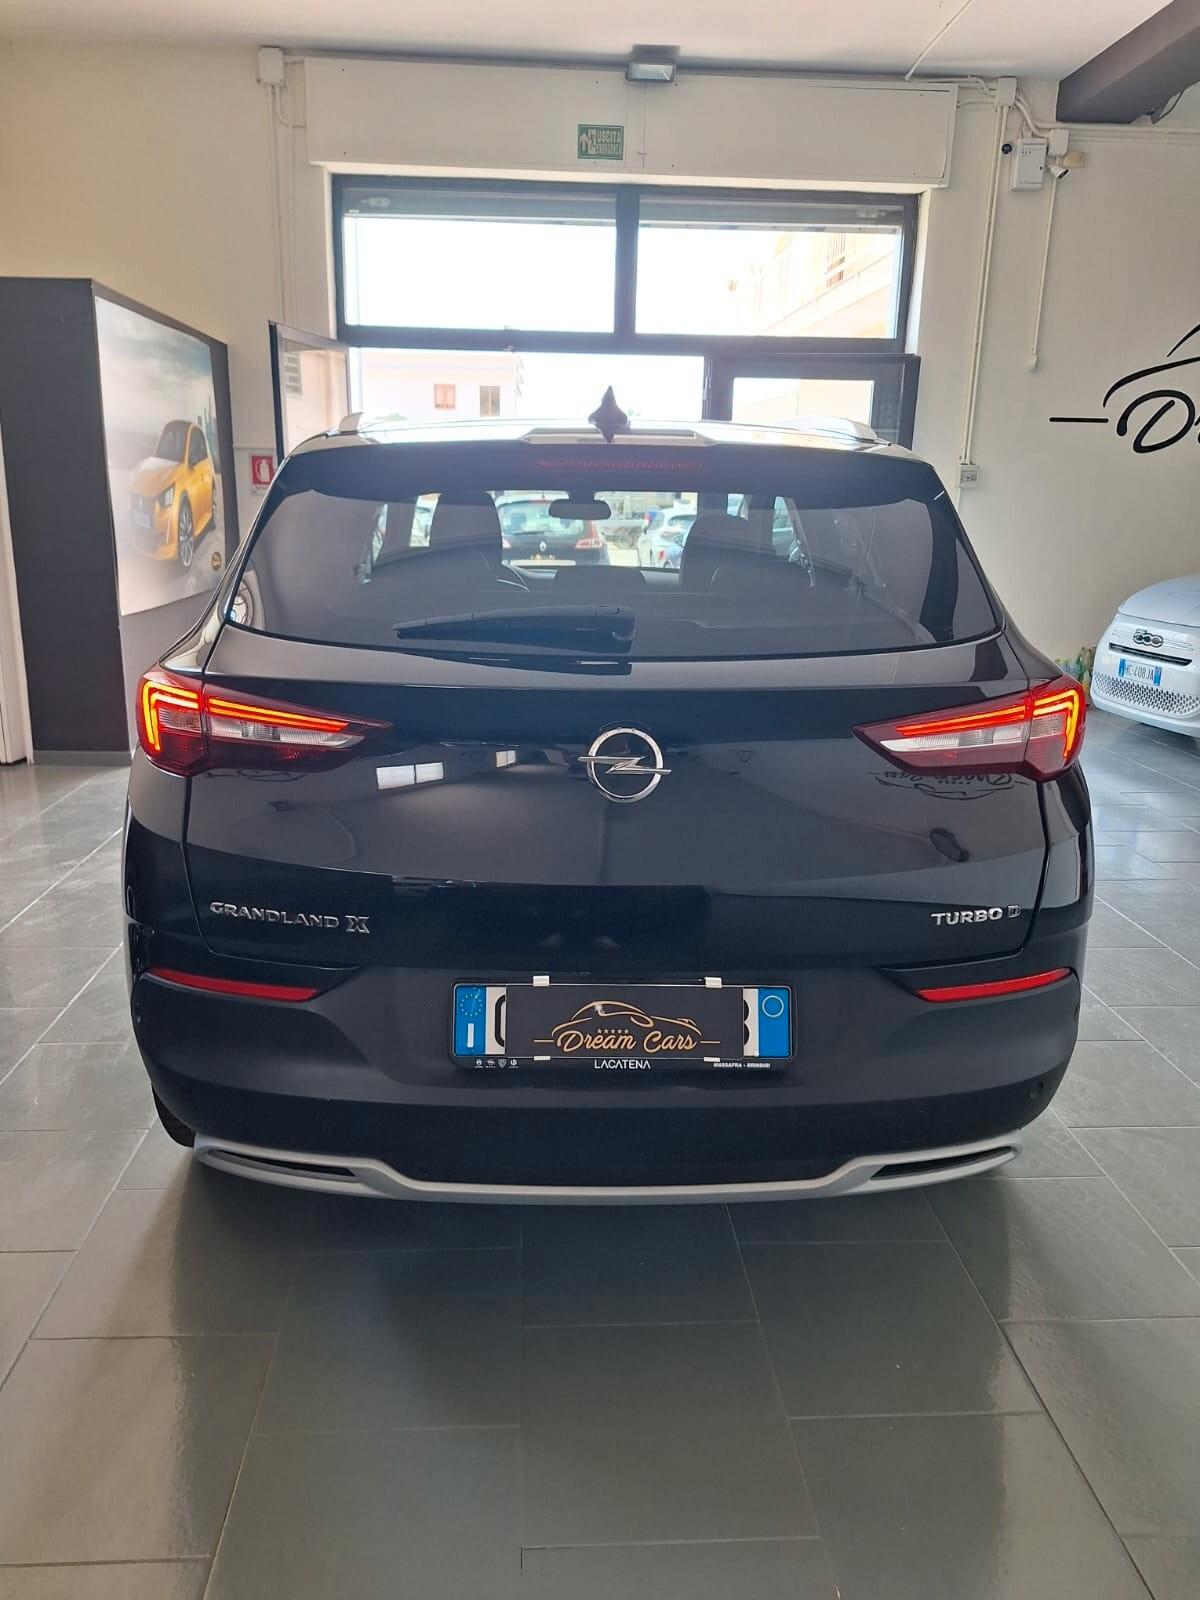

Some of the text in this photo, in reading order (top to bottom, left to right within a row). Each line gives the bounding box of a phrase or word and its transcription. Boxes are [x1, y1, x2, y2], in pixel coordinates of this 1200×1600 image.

[597, 130, 621, 144] USCITA
[209, 901, 370, 934] GRANDLAND X
[930, 904, 1021, 926] TURBO D
[556, 1030, 697, 1053] Dream Cars
[594, 1059, 651, 1069] LACATENA
